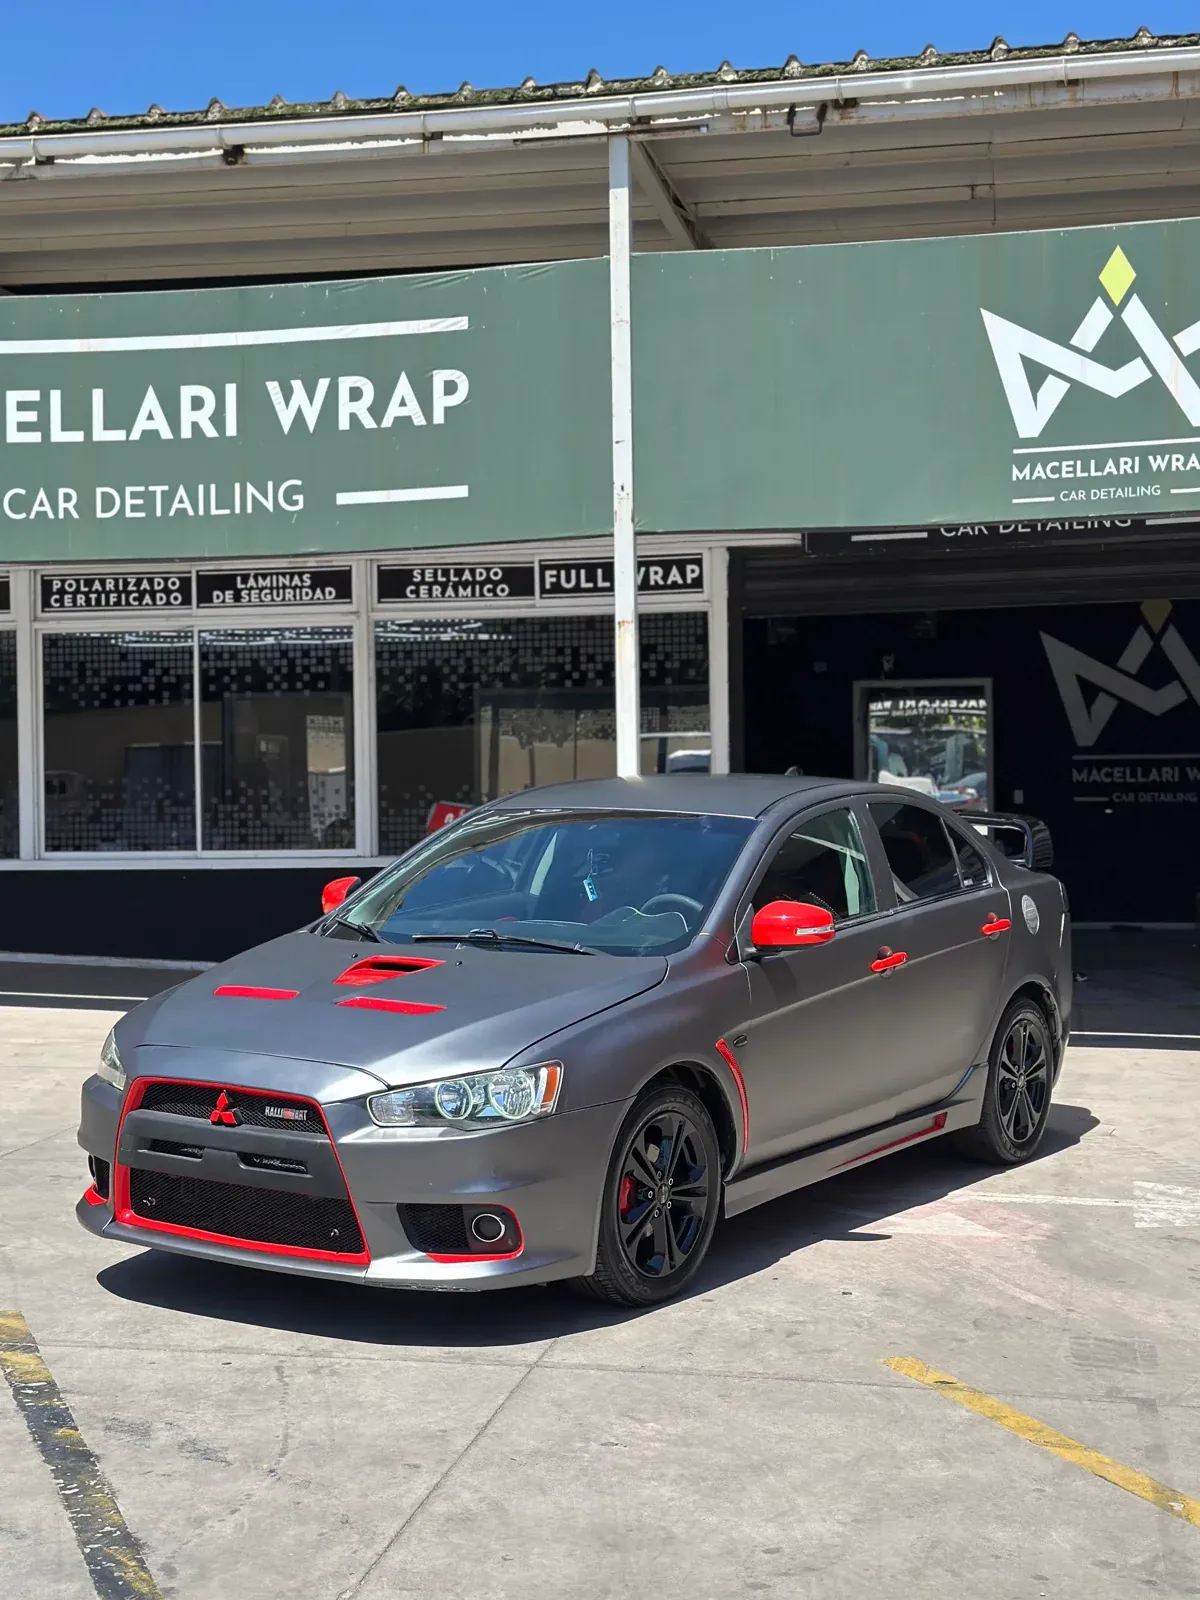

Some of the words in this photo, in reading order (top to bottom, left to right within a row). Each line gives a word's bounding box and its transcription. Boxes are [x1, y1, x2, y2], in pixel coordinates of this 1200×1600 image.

[5, 383, 238, 444] ELLARI
[265, 368, 470, 436] WRAP
[1012, 456, 1140, 482] MACELLARI
[1148, 452, 1200, 473] WRA
[3, 487, 79, 521] CAR
[96, 479, 304, 519] DETAILING
[1060, 490, 1087, 502] CAR
[1090, 485, 1161, 500] DETAILING
[236, 573, 312, 590] LÁMINAS
[412, 567, 503, 582] SELLADO
[544, 568, 611, 591] FULL
[52, 577, 181, 593] POLARIZADO
[405, 582, 510, 599] CERÁMICO
[50, 592, 183, 608] CERTIFICADO
[212, 590, 235, 604] DE
[240, 587, 336, 603] SEGURIDAD
[1072, 766, 1179, 783] MACELLARI
[1112, 792, 1136, 802] CAR
[1138, 791, 1198, 802] DETAILING
